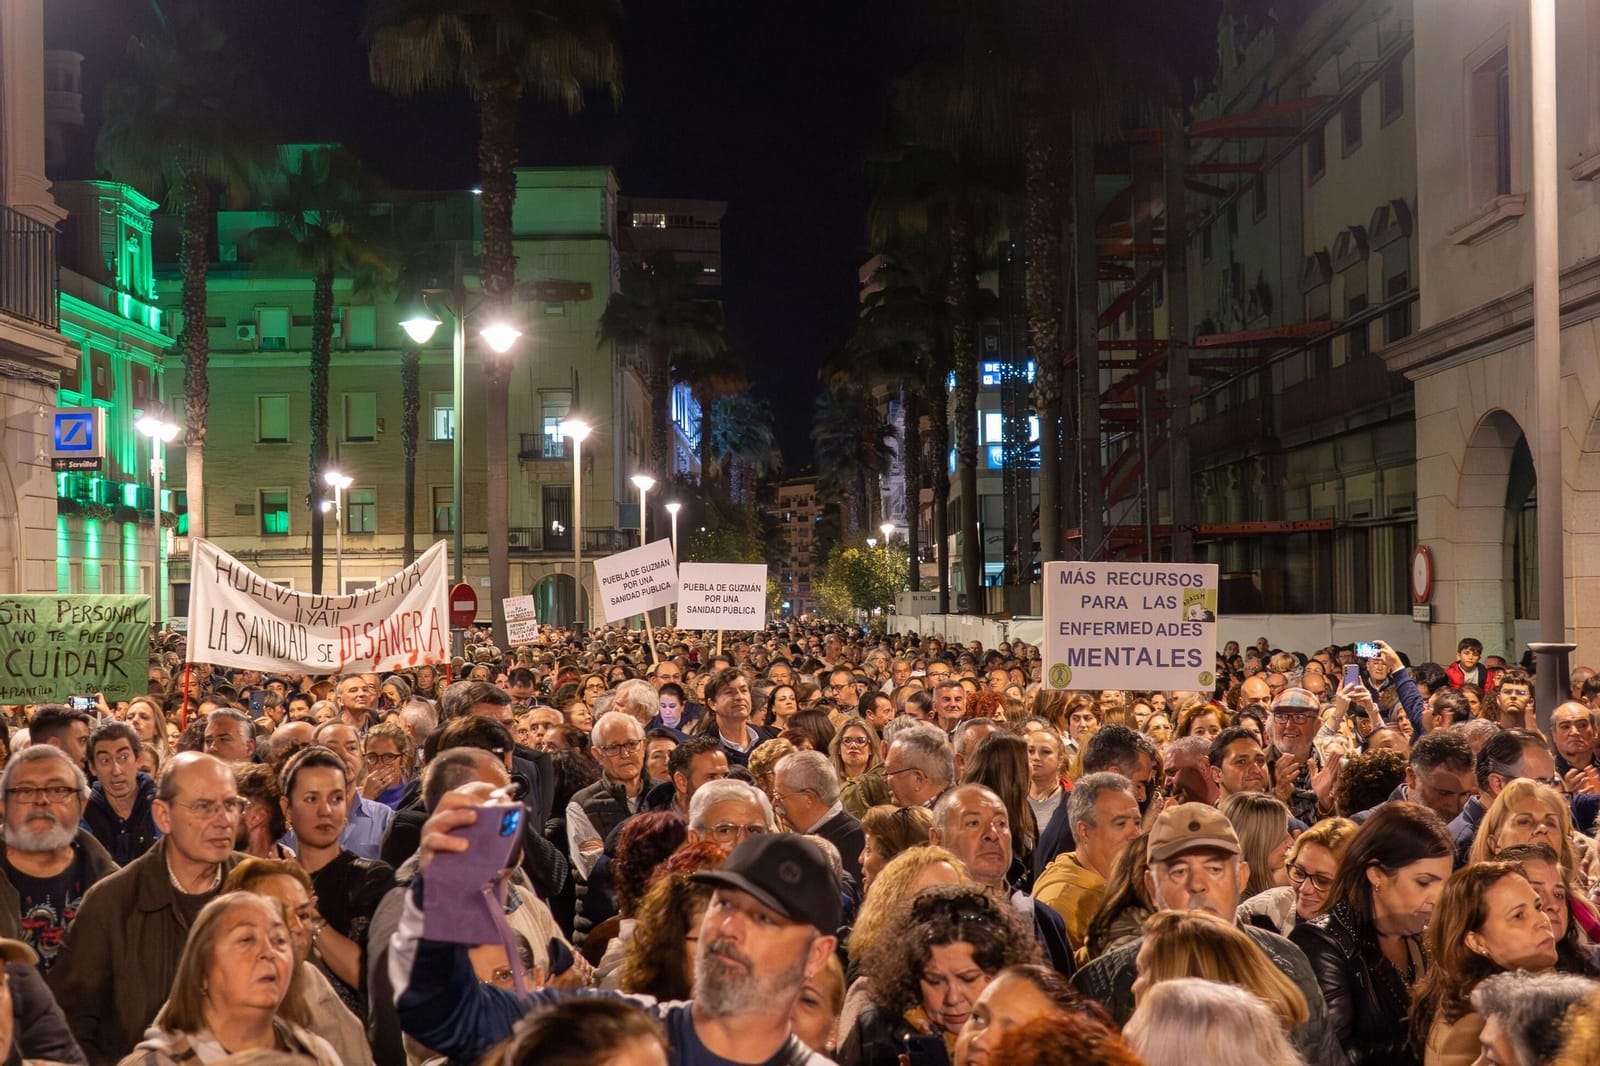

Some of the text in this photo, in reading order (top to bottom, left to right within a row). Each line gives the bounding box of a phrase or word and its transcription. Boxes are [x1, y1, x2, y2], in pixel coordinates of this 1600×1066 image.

[602, 558, 671, 586] PUEBLA DE GUZMÁN
[1060, 568, 1203, 587] MÁS RECURSOS
[215, 555, 300, 608] HUELVA
[623, 575, 654, 590] POR UNA
[683, 582, 761, 592] PUEBLA DE GUZMÁN
[610, 590, 641, 606] SANIDAD
[705, 594, 740, 603] POR UNA
[1081, 595, 1177, 609] PARA LAS
[57, 599, 147, 624] PERSONAL
[686, 605, 721, 614] SANIDAD
[13, 629, 125, 643] NO TE PUEDO
[208, 607, 445, 662] LA SANIDAD SE DESANGRA
[1059, 621, 1203, 636] ENFERMEDADES
[1067, 647, 1203, 667] MENTALES
